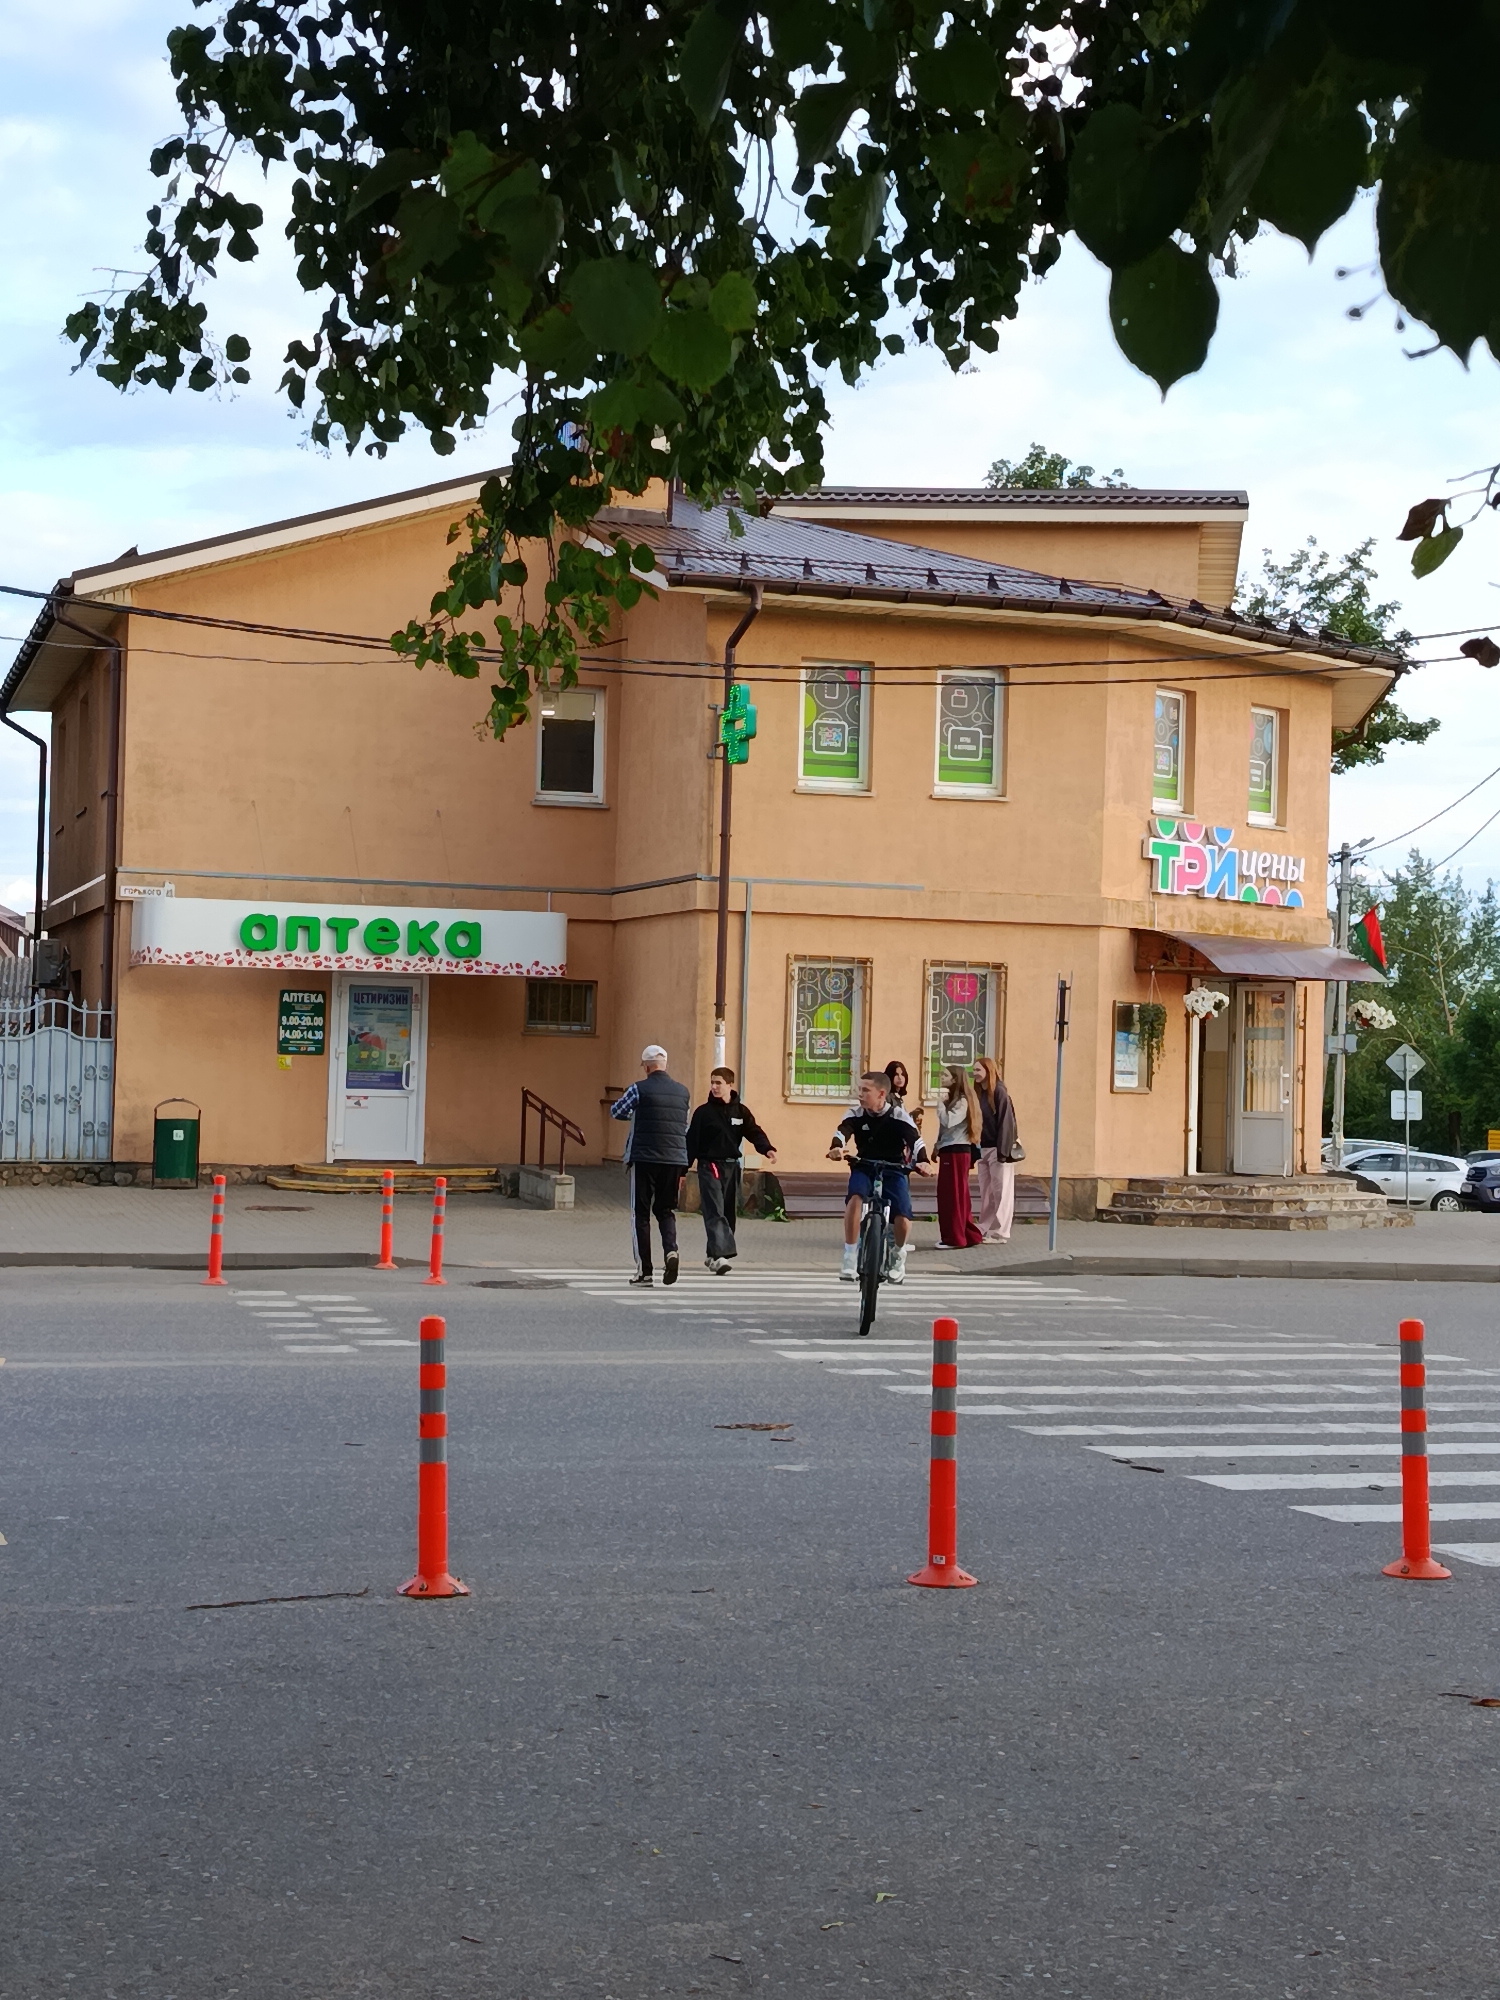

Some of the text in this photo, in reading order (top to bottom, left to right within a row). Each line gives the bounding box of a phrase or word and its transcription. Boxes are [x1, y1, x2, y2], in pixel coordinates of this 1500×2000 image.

[1149, 838, 1306, 900] ТРИ цены
[240, 913, 482, 959] аптека
[282, 992, 324, 1004] АПТЕКА
[353, 992, 408, 1005] ЦЕТИРИЗИН
